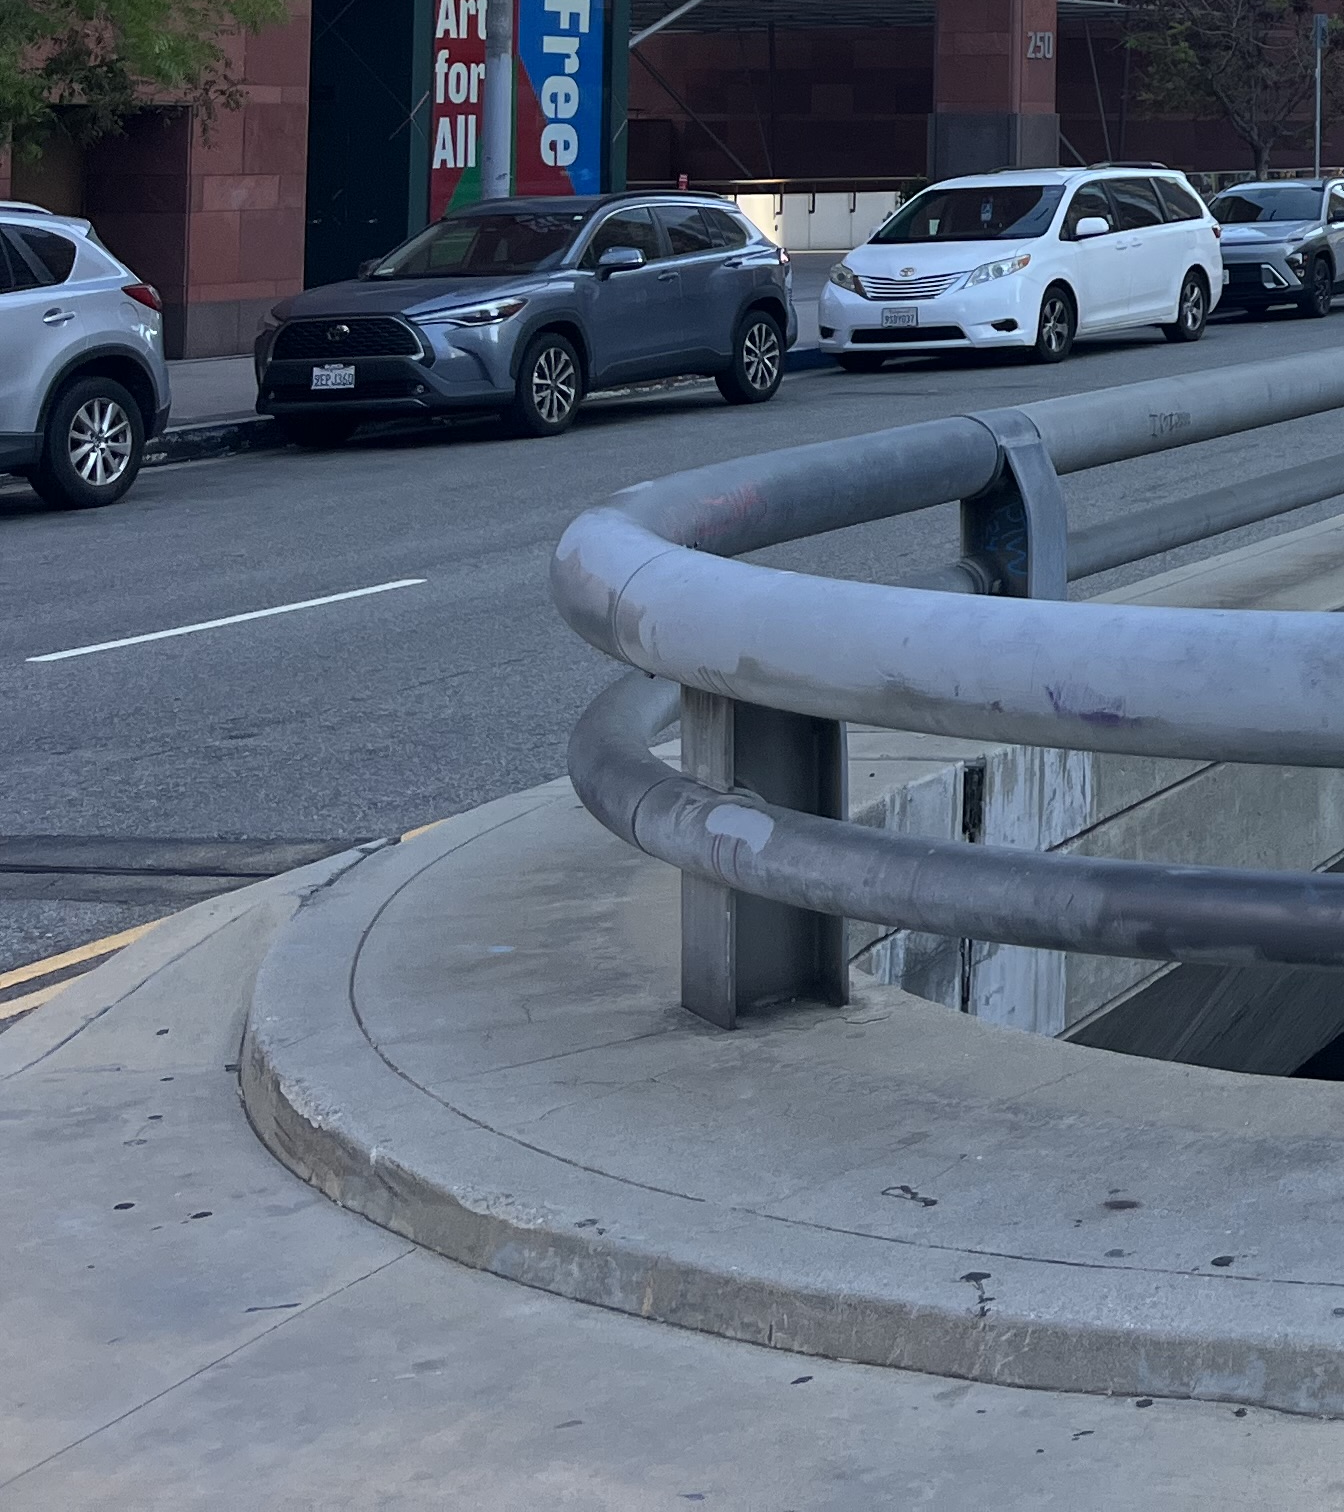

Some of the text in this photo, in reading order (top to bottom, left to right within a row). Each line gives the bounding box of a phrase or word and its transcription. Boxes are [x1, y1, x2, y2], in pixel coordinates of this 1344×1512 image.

[1027, 31, 1053, 60] 250
[435, 49, 486, 104] for
[432, 115, 477, 169] All
